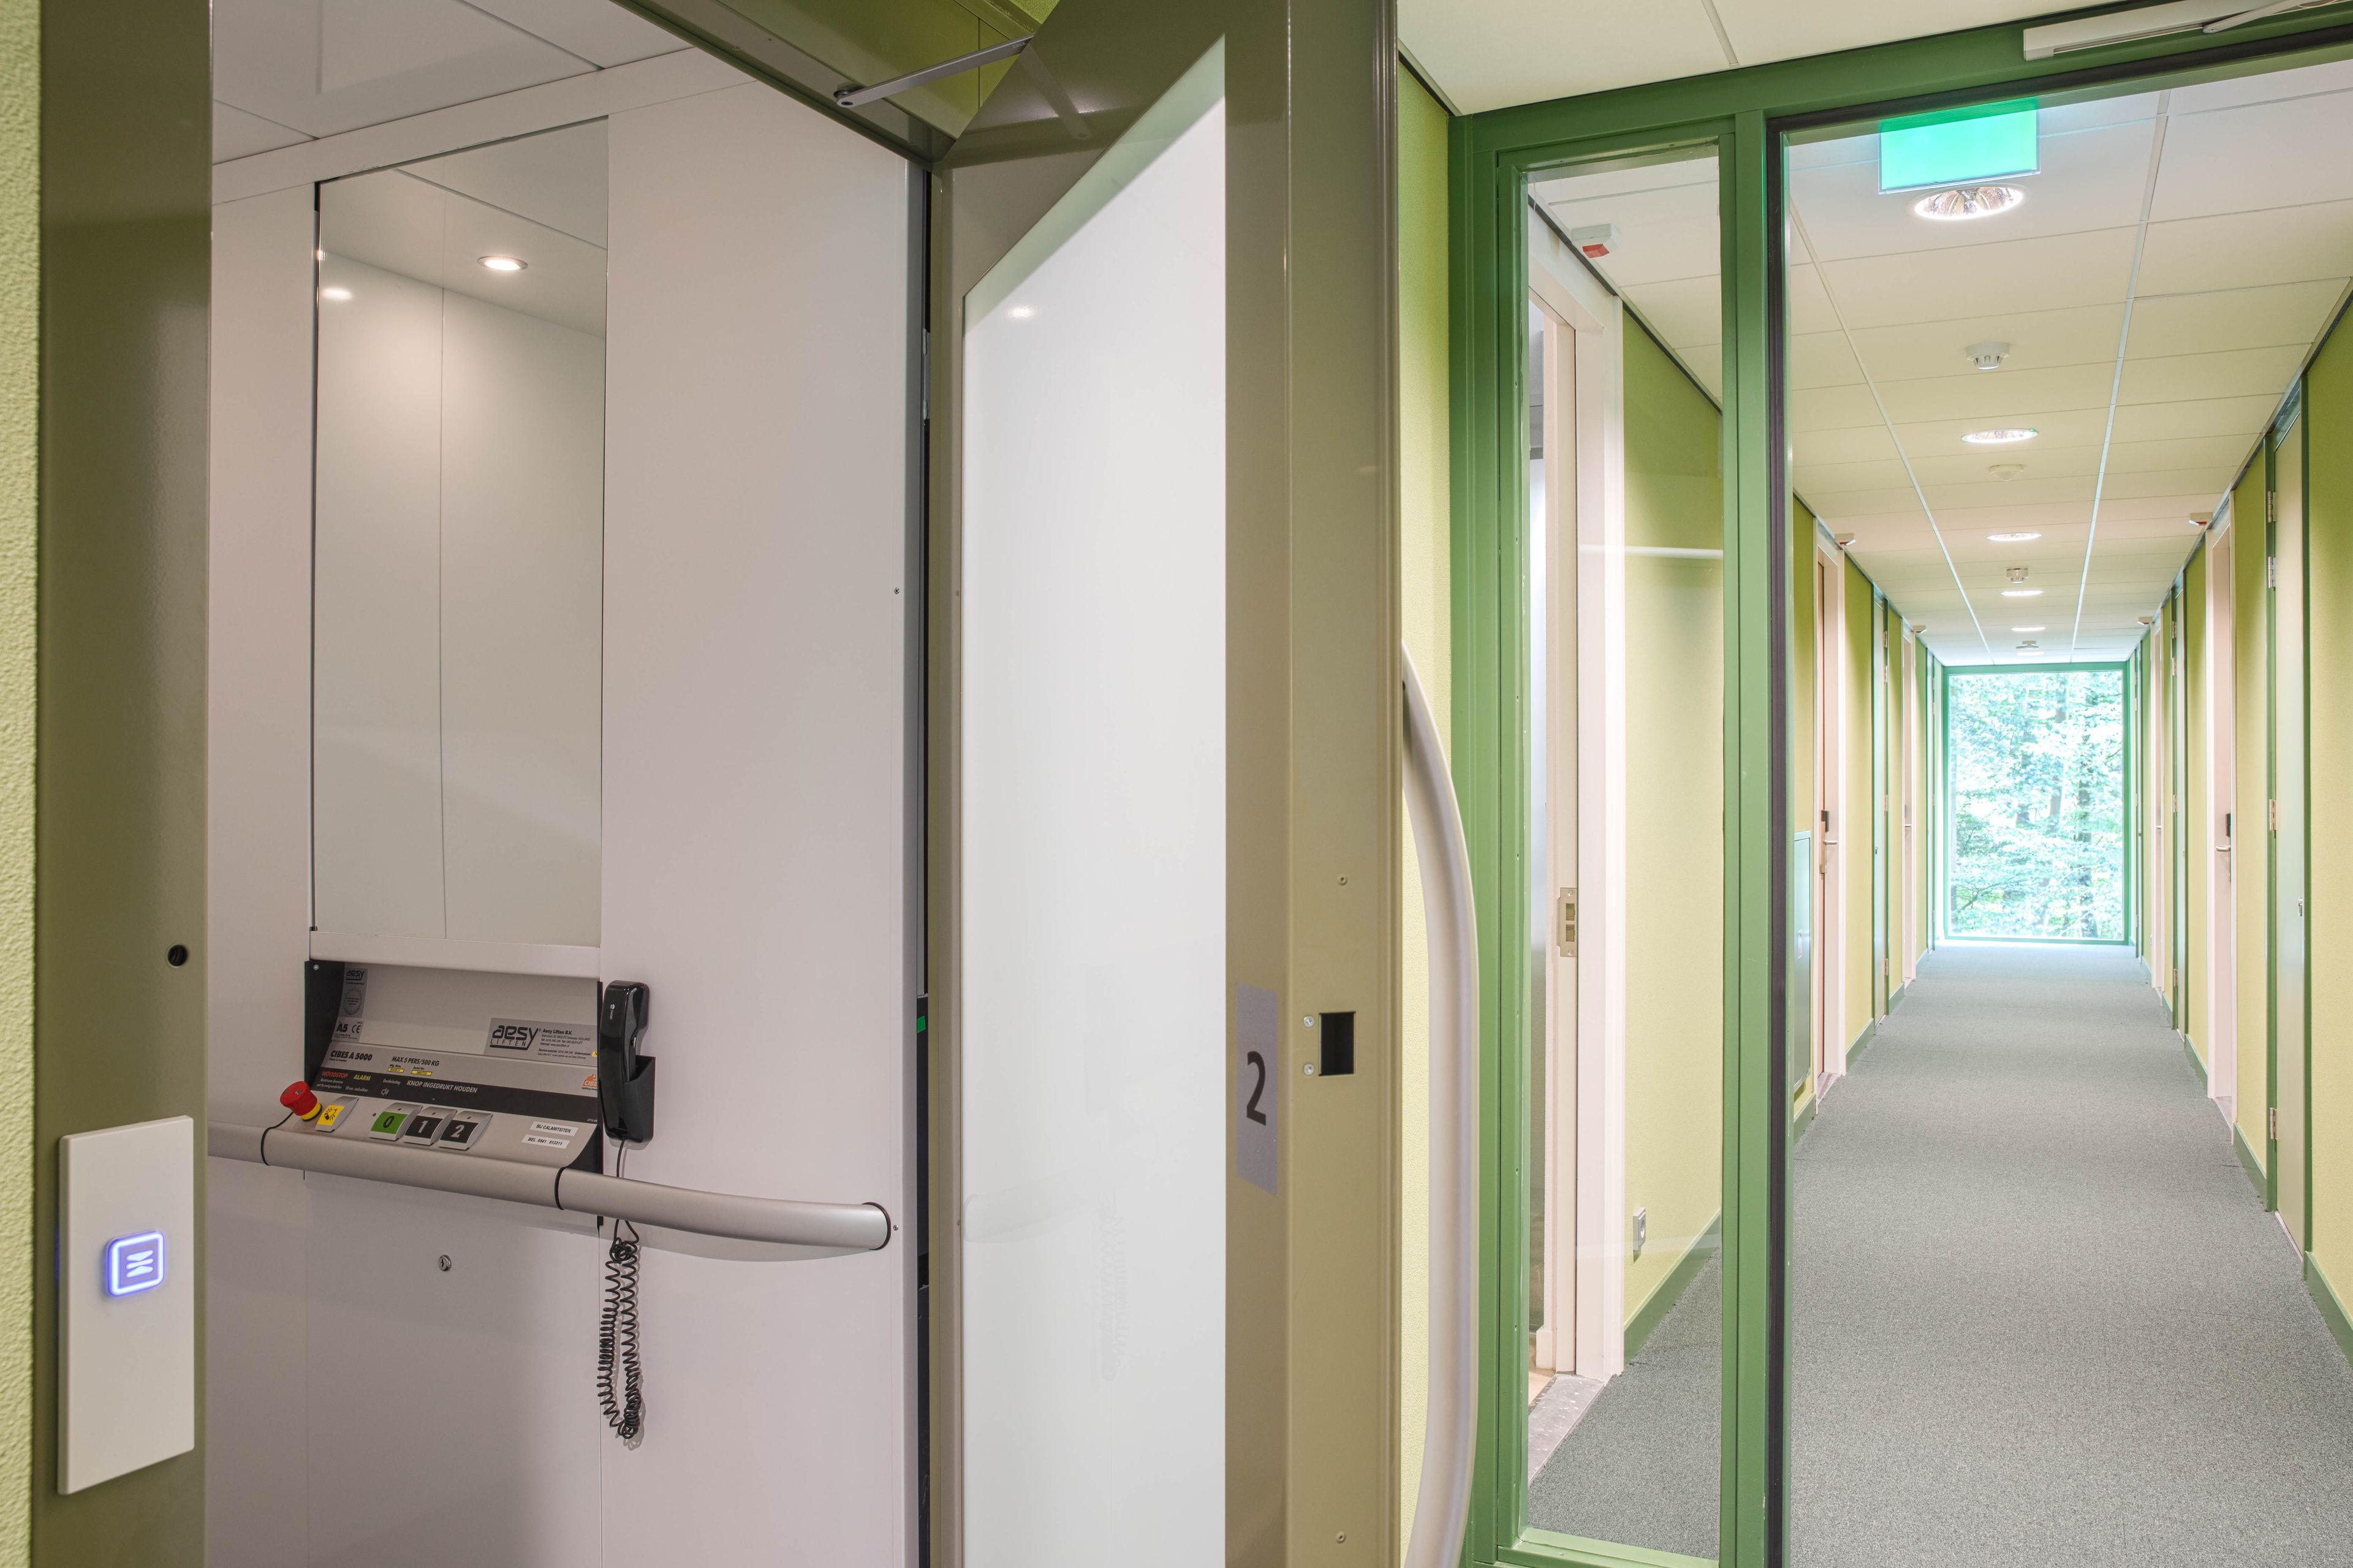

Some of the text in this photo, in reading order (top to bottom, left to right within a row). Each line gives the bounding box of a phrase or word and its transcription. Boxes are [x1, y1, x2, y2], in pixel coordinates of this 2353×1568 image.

[336, 1023, 348, 1032] A5
[492, 1025, 539, 1042] aesy
[330, 1050, 349, 1059] CIBES
[355, 1053, 373, 1061] 5000
[423, 1081, 454, 1091] INGEDRUKT
[1246, 1050, 1266, 1126] 2
[383, 1115, 395, 1129] 0
[418, 1120, 429, 1134] 1
[450, 1124, 464, 1138] 2
